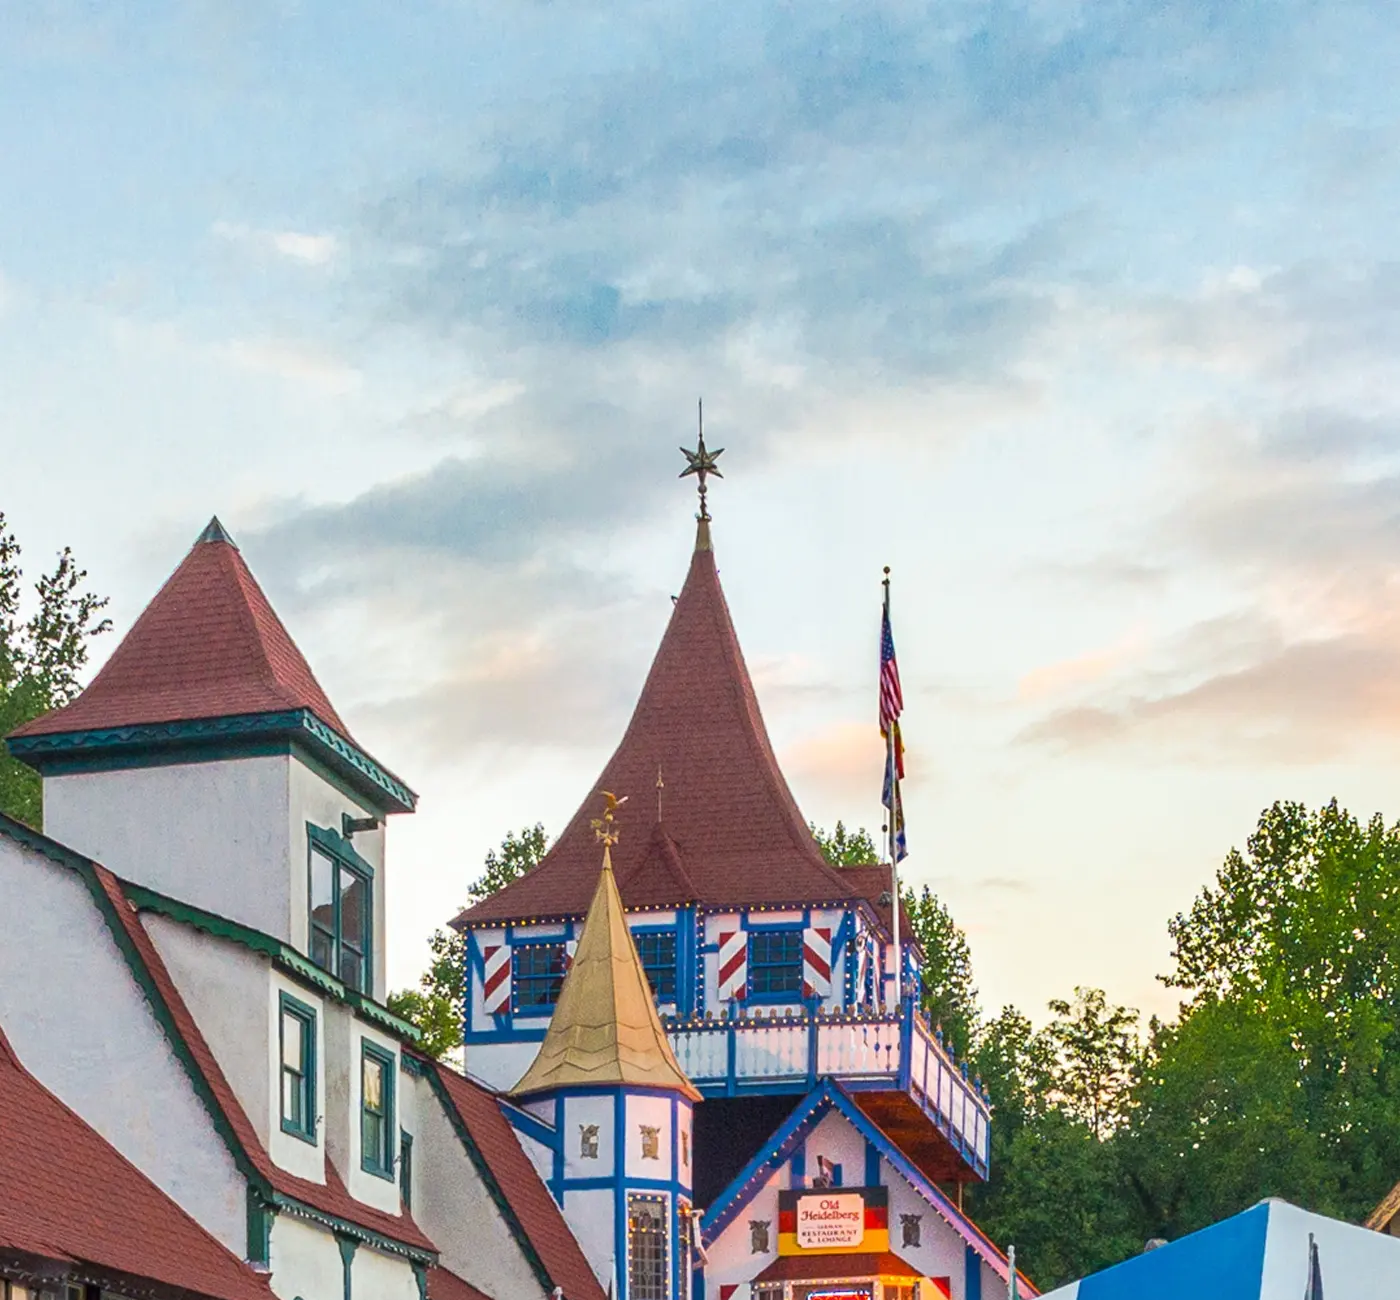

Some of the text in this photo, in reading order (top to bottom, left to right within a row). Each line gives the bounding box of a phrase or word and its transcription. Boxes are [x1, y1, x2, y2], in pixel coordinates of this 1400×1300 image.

[819, 1199, 840, 1210] Old
[800, 1210, 860, 1221] Heidelberg
[801, 1229, 858, 1237] RESTAURANT
